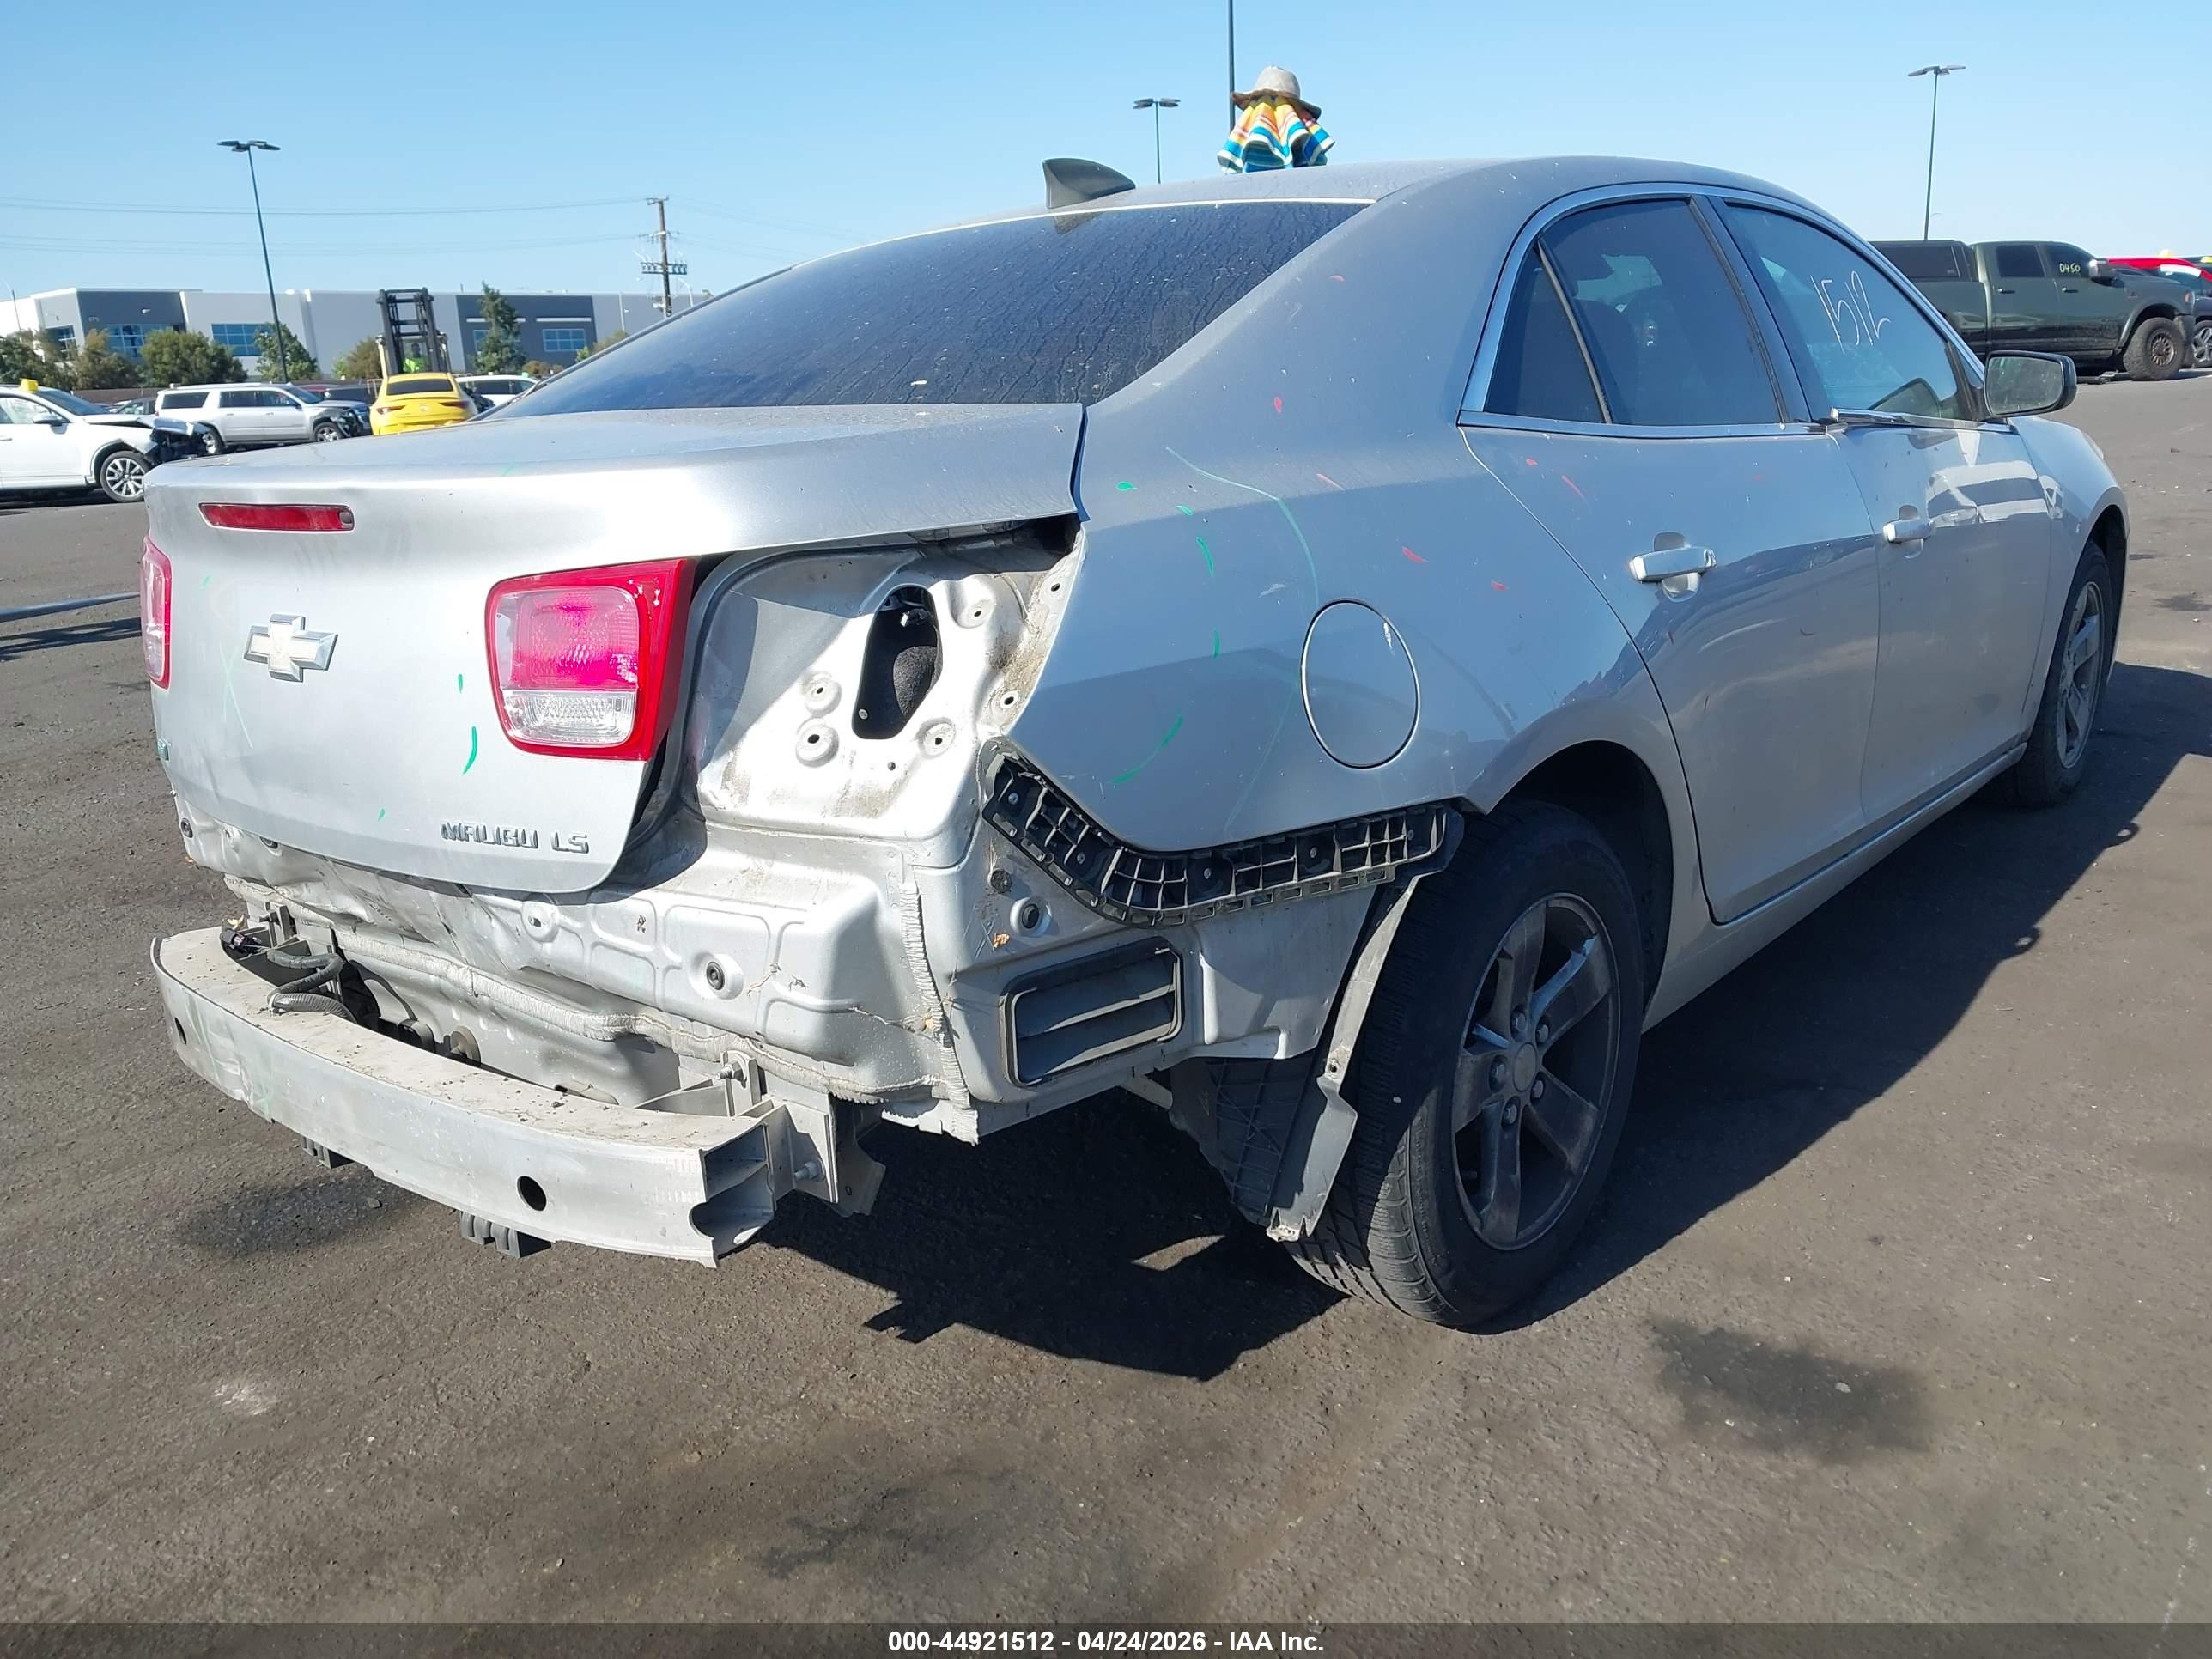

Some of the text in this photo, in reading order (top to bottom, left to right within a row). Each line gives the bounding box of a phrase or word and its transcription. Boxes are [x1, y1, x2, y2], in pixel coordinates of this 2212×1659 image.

[1809, 270, 1892, 355] 1512
[440, 821, 590, 854] MALIBU LS
